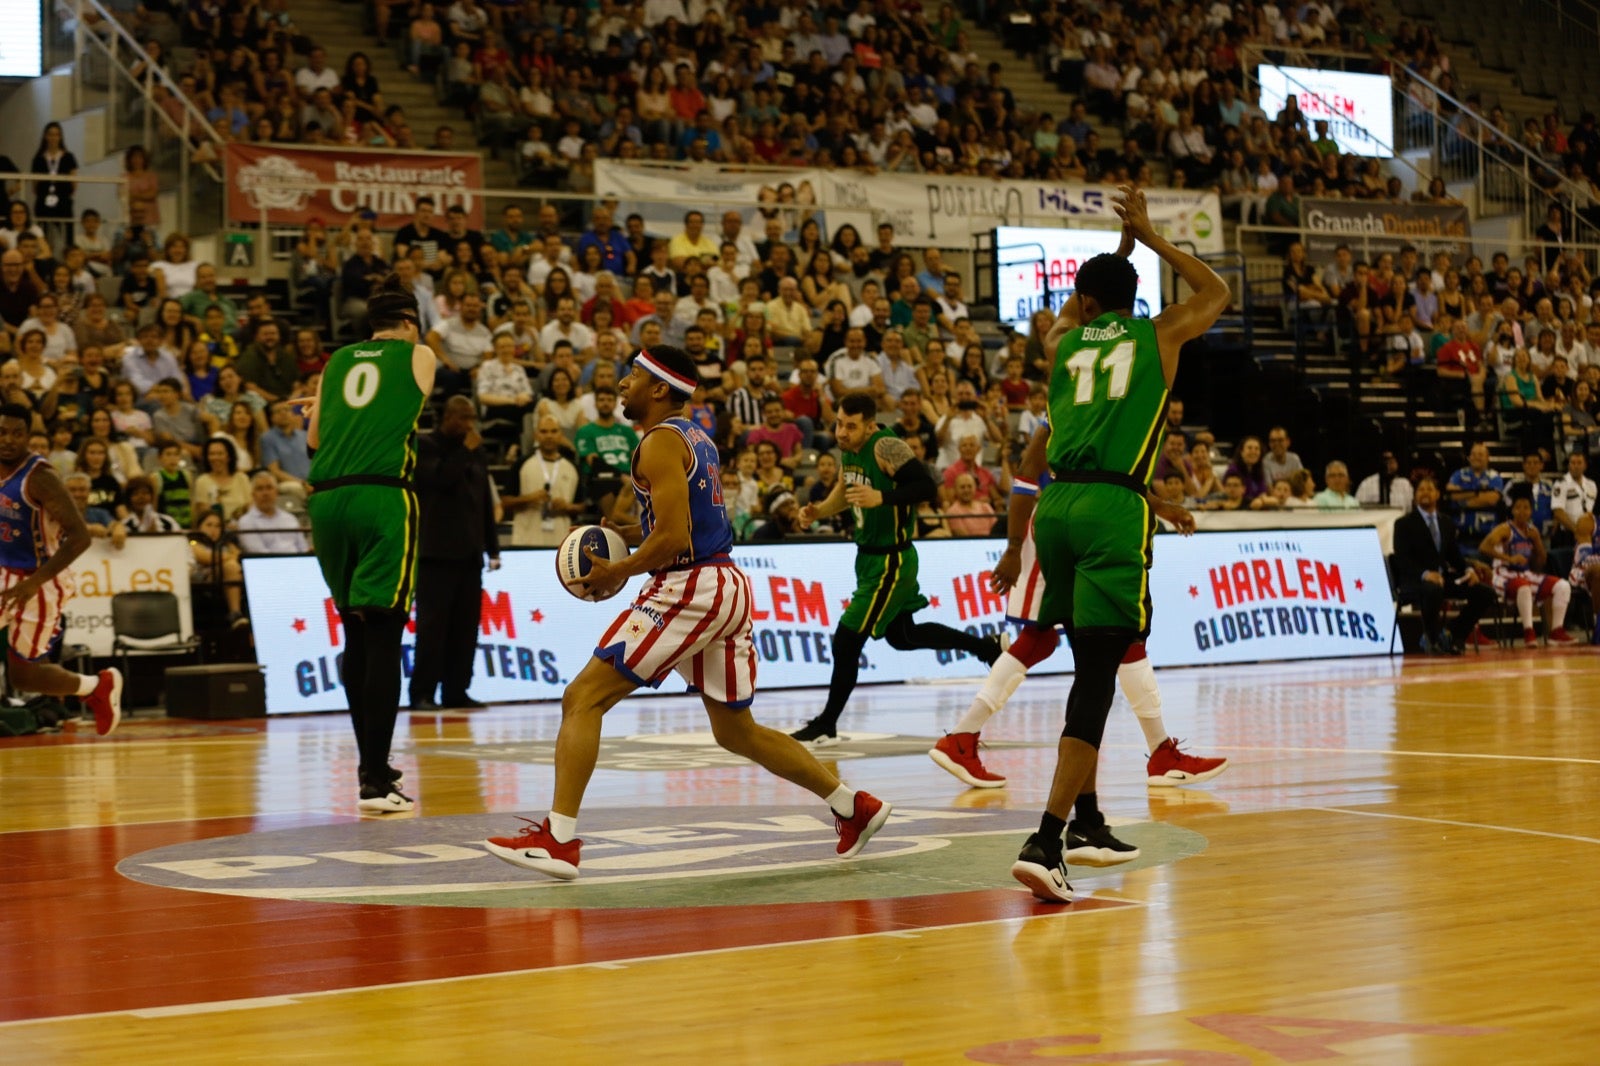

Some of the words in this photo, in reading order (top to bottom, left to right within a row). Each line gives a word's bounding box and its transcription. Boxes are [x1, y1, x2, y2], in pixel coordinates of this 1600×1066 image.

[1299, 91, 1354, 119] ARLEM
[334, 161, 466, 186] Restaurante
[231, 243, 249, 265] A
[342, 361, 380, 410] 0
[1065, 340, 1136, 405] 11
[75, 559, 174, 597] al.es
[749, 574, 830, 627] LEM
[1209, 558, 1346, 610] HARLEM
[1194, 605, 1386, 651] GLOBETROTTERS.
